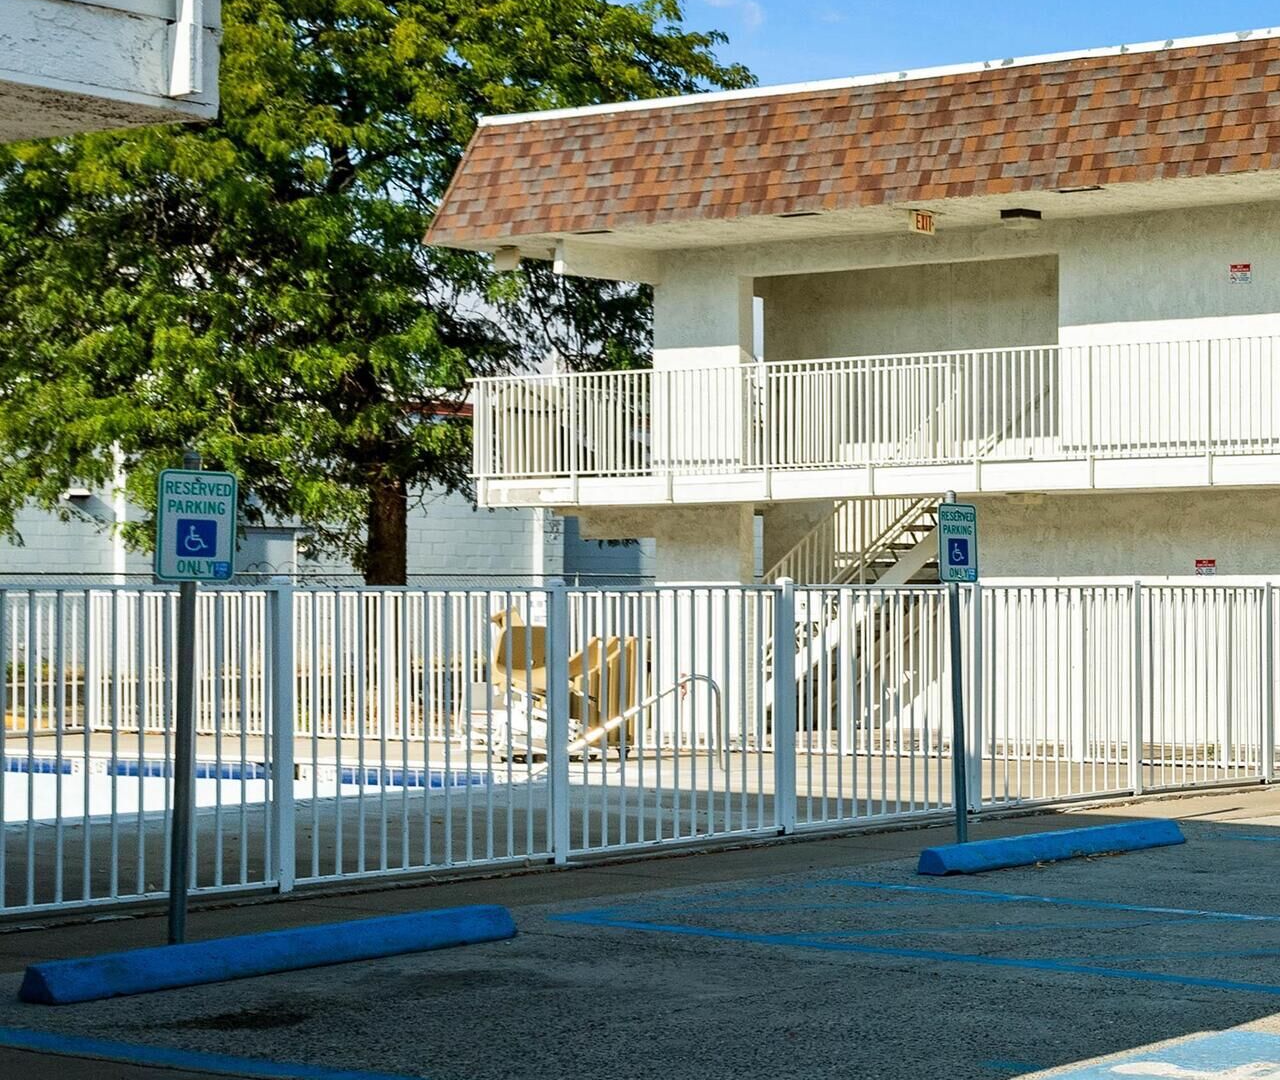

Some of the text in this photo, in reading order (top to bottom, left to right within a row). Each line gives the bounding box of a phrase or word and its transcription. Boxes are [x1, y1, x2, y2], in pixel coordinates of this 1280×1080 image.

[165, 481, 232, 497] RESERVED
[168, 499, 225, 515] PARKING
[941, 510, 975, 522] RESERVED
[943, 524, 972, 536] PARKING
[177, 560, 214, 575] ONLY
[949, 568, 968, 578] ONLY
